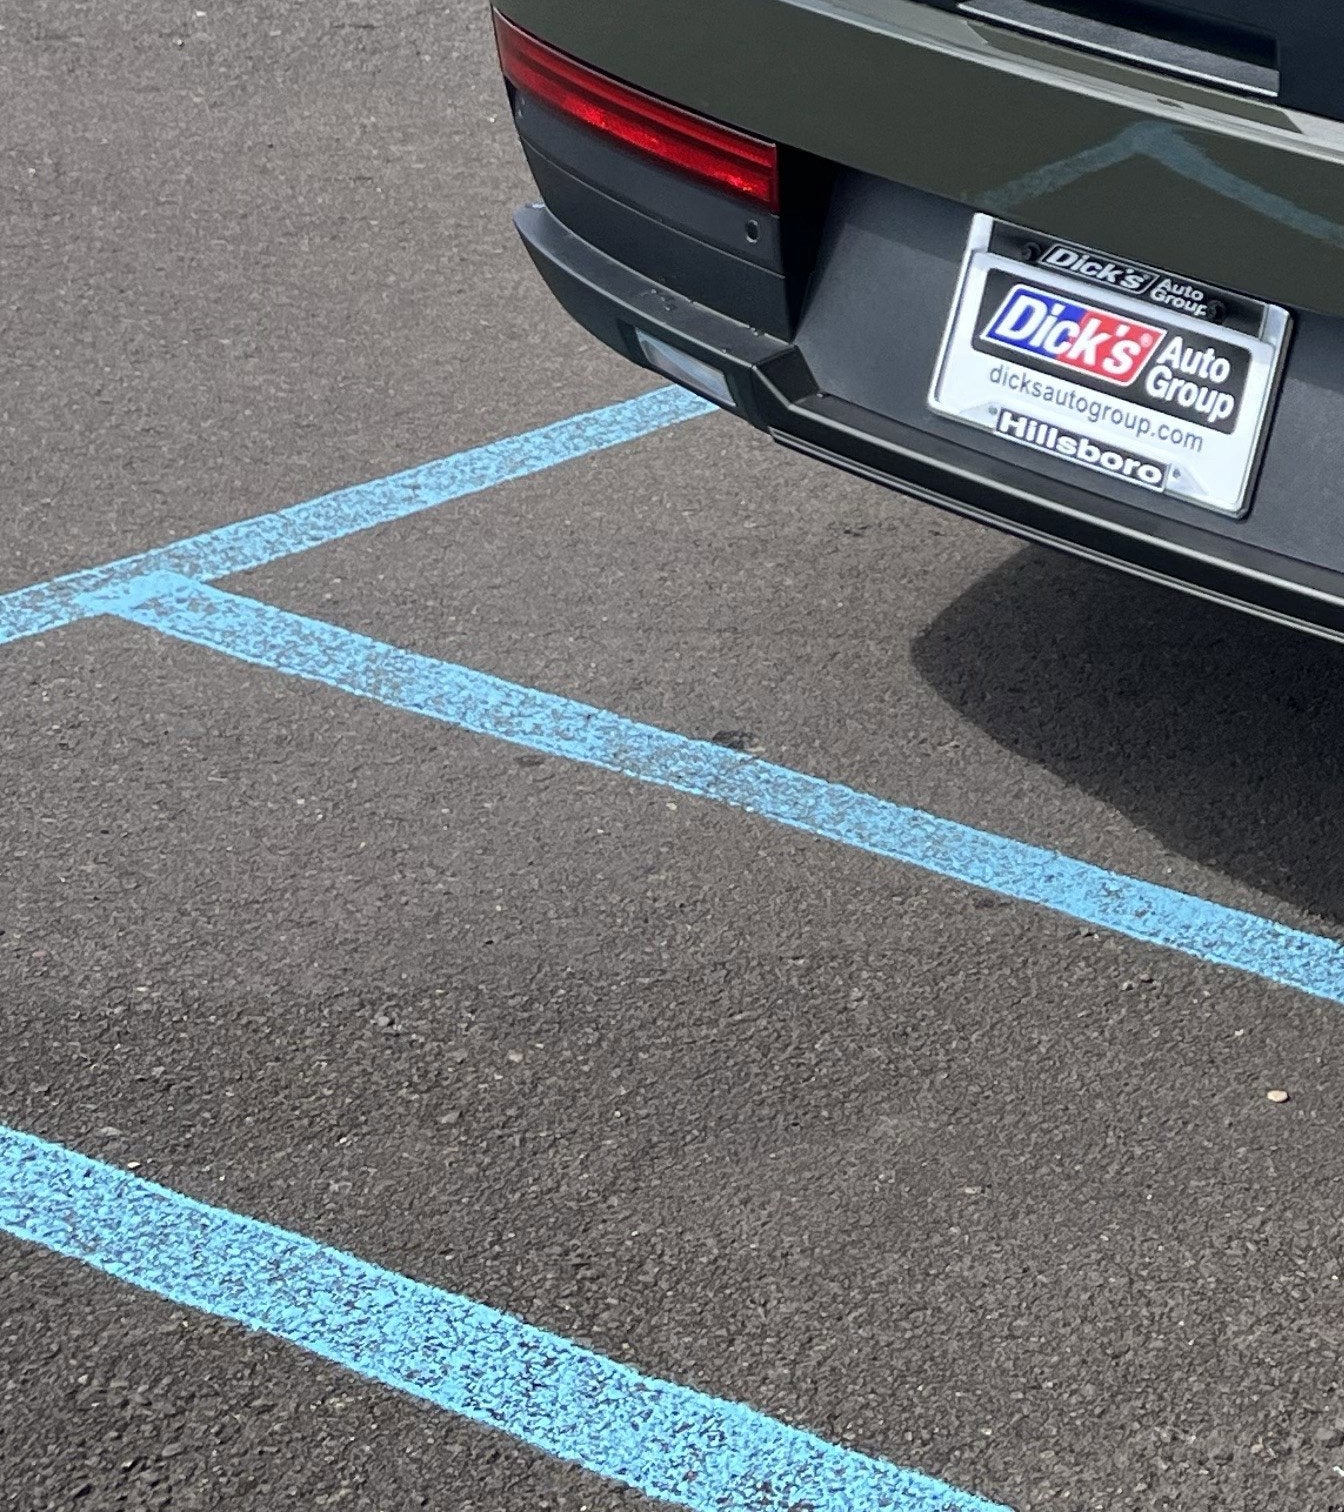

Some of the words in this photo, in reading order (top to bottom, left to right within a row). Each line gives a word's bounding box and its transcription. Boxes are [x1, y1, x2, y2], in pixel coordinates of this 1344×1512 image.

[1046, 247, 1144, 290] Dick's
[1156, 278, 1204, 301] Auto
[995, 296, 1142, 376] Dick's
[1157, 335, 1231, 384] Auto
[989, 365, 1204, 452] dicksautogroup.com
[1146, 364, 1236, 424] Group
[999, 412, 1163, 486] Hillsboro
